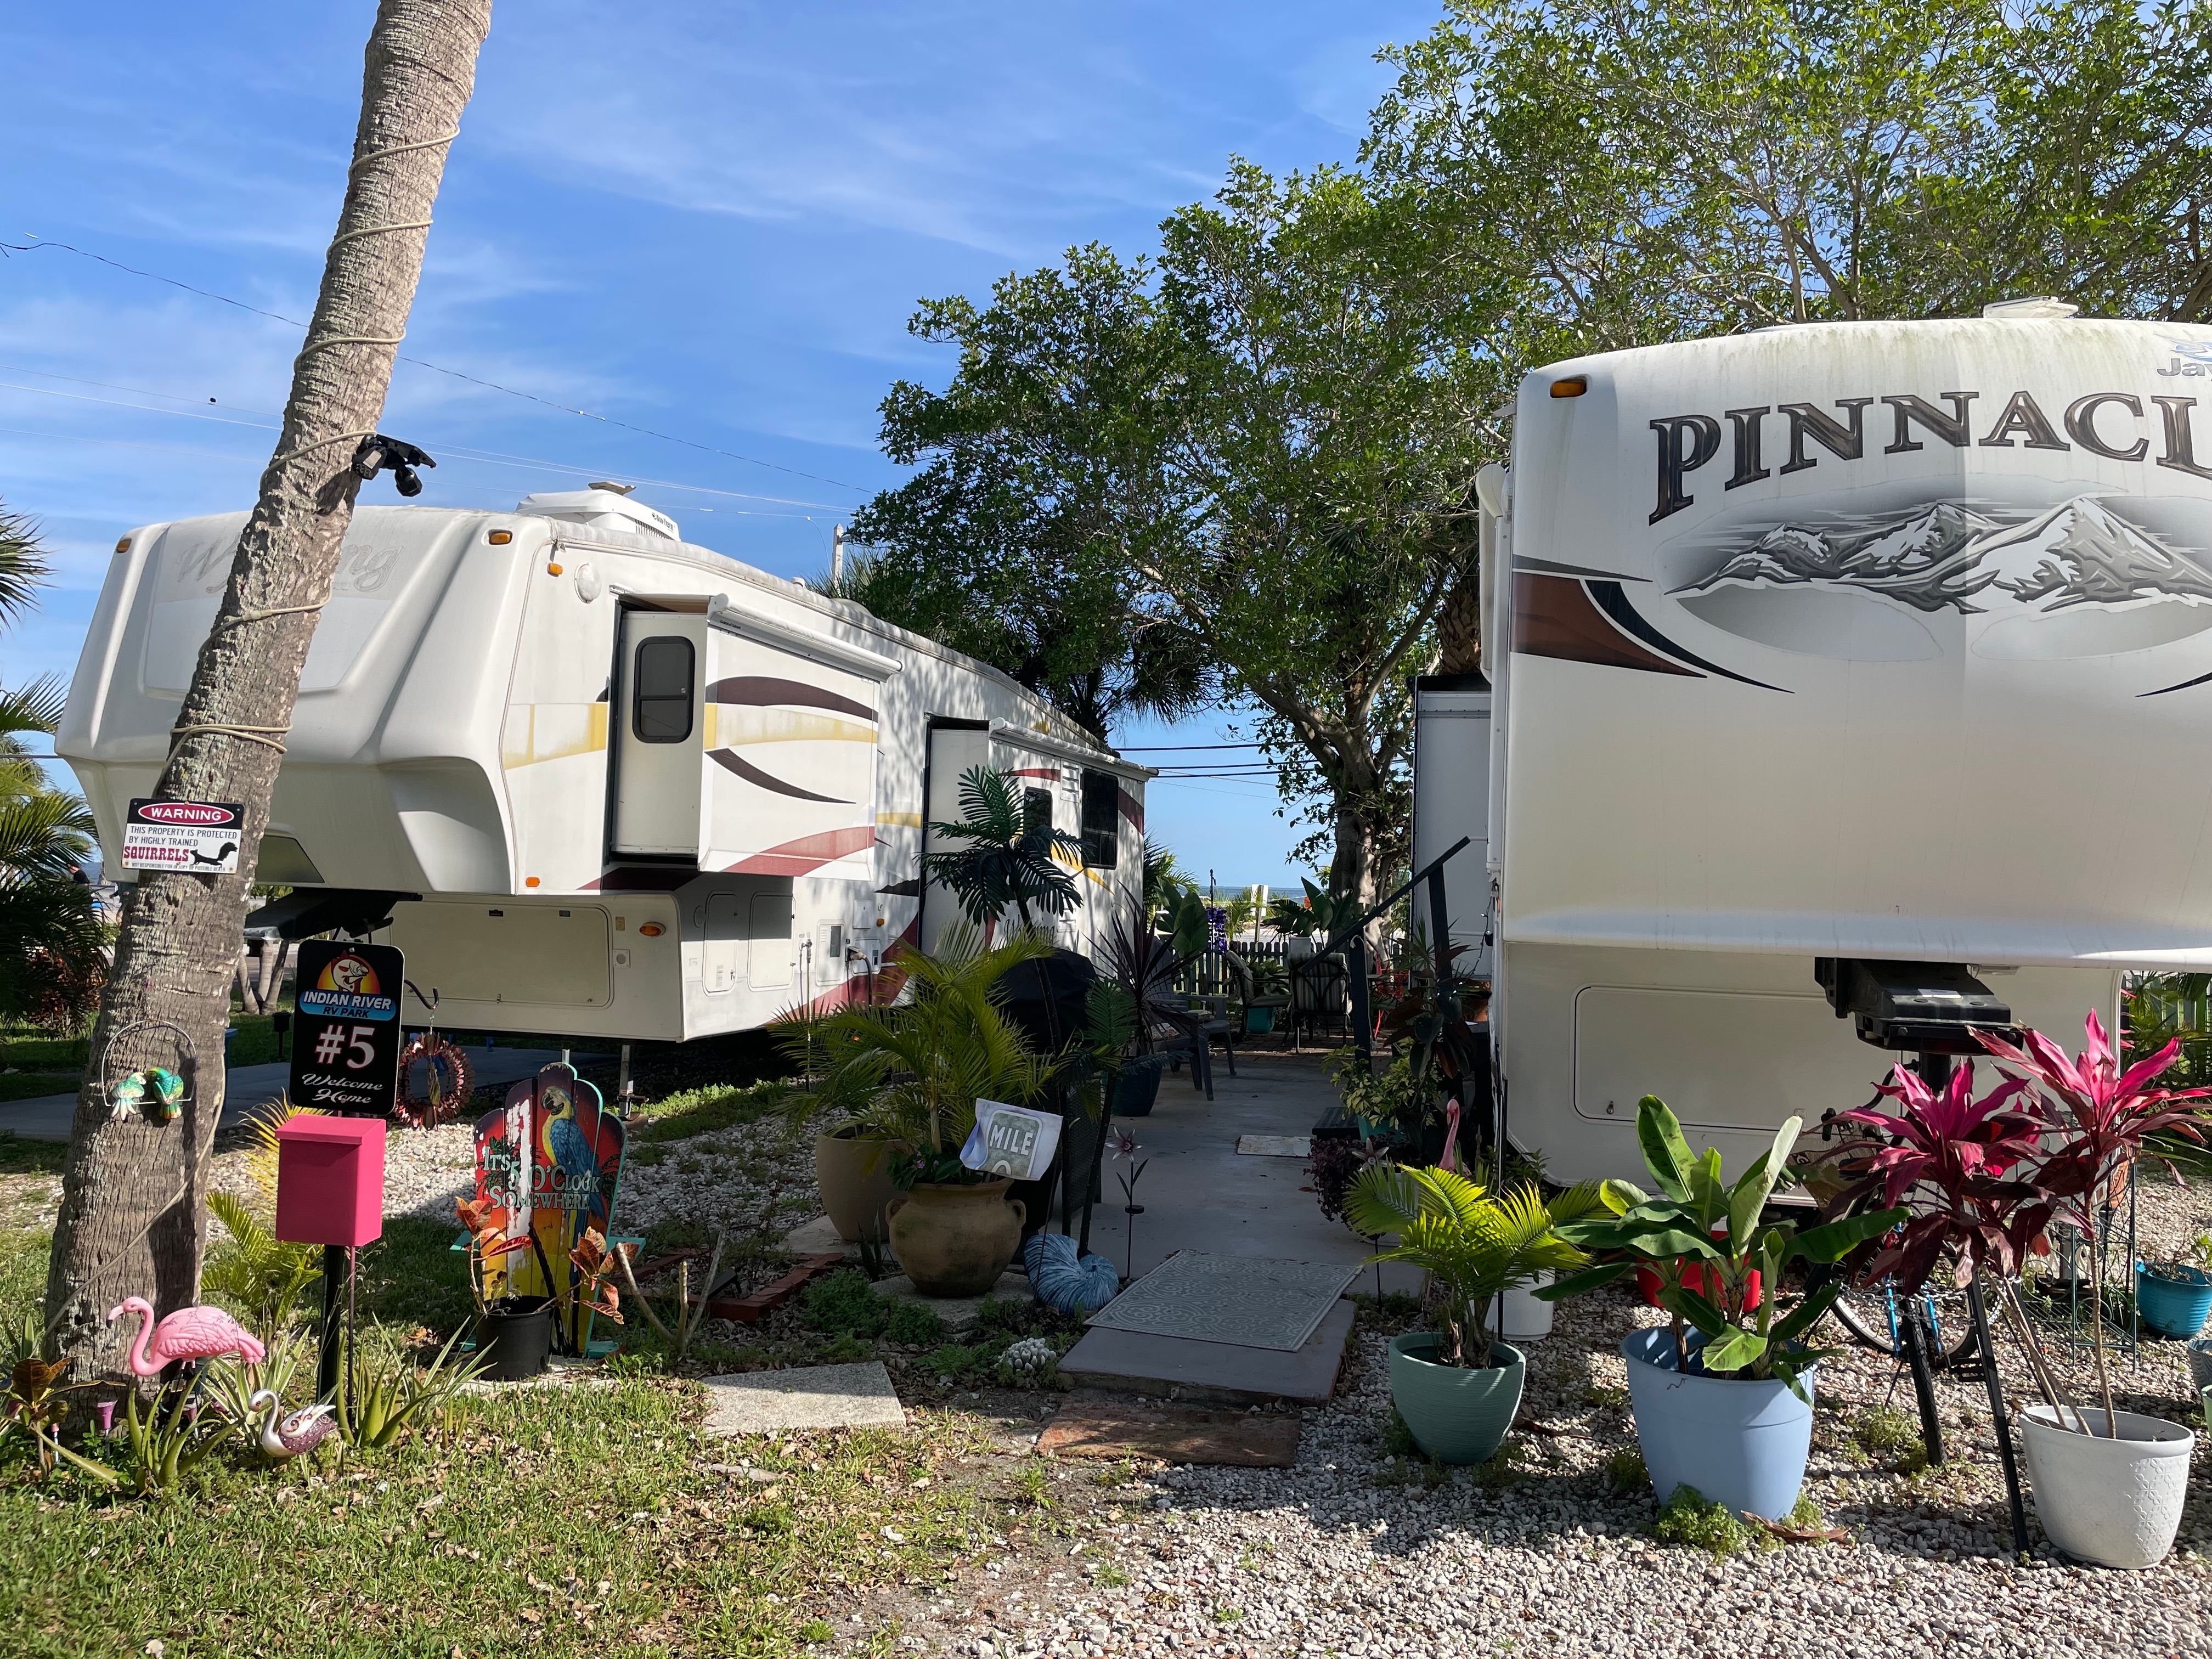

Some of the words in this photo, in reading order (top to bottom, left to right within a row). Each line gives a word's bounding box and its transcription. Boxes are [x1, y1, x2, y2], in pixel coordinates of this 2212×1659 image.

[1649, 391, 2212, 526] PINNACL
[151, 808, 222, 821] WARNING
[148, 827, 185, 836] PROPERTY
[197, 830, 237, 839] PROTECTED
[141, 837, 166, 845] HIGHLY
[169, 838, 198, 847] TRAINED
[123, 846, 189, 861] SQUIRRELS
[303, 991, 349, 1006] INDIAN
[352, 995, 391, 1010] RIVER
[323, 1006, 340, 1014] RV
[340, 1008, 370, 1018] PARK
[315, 1024, 375, 1069] #5
[302, 1074, 383, 1090] Welcome
[312, 1088, 372, 1103] Home
[989, 1125, 1034, 1155] MILE
[508, 1161, 520, 1190] 5
